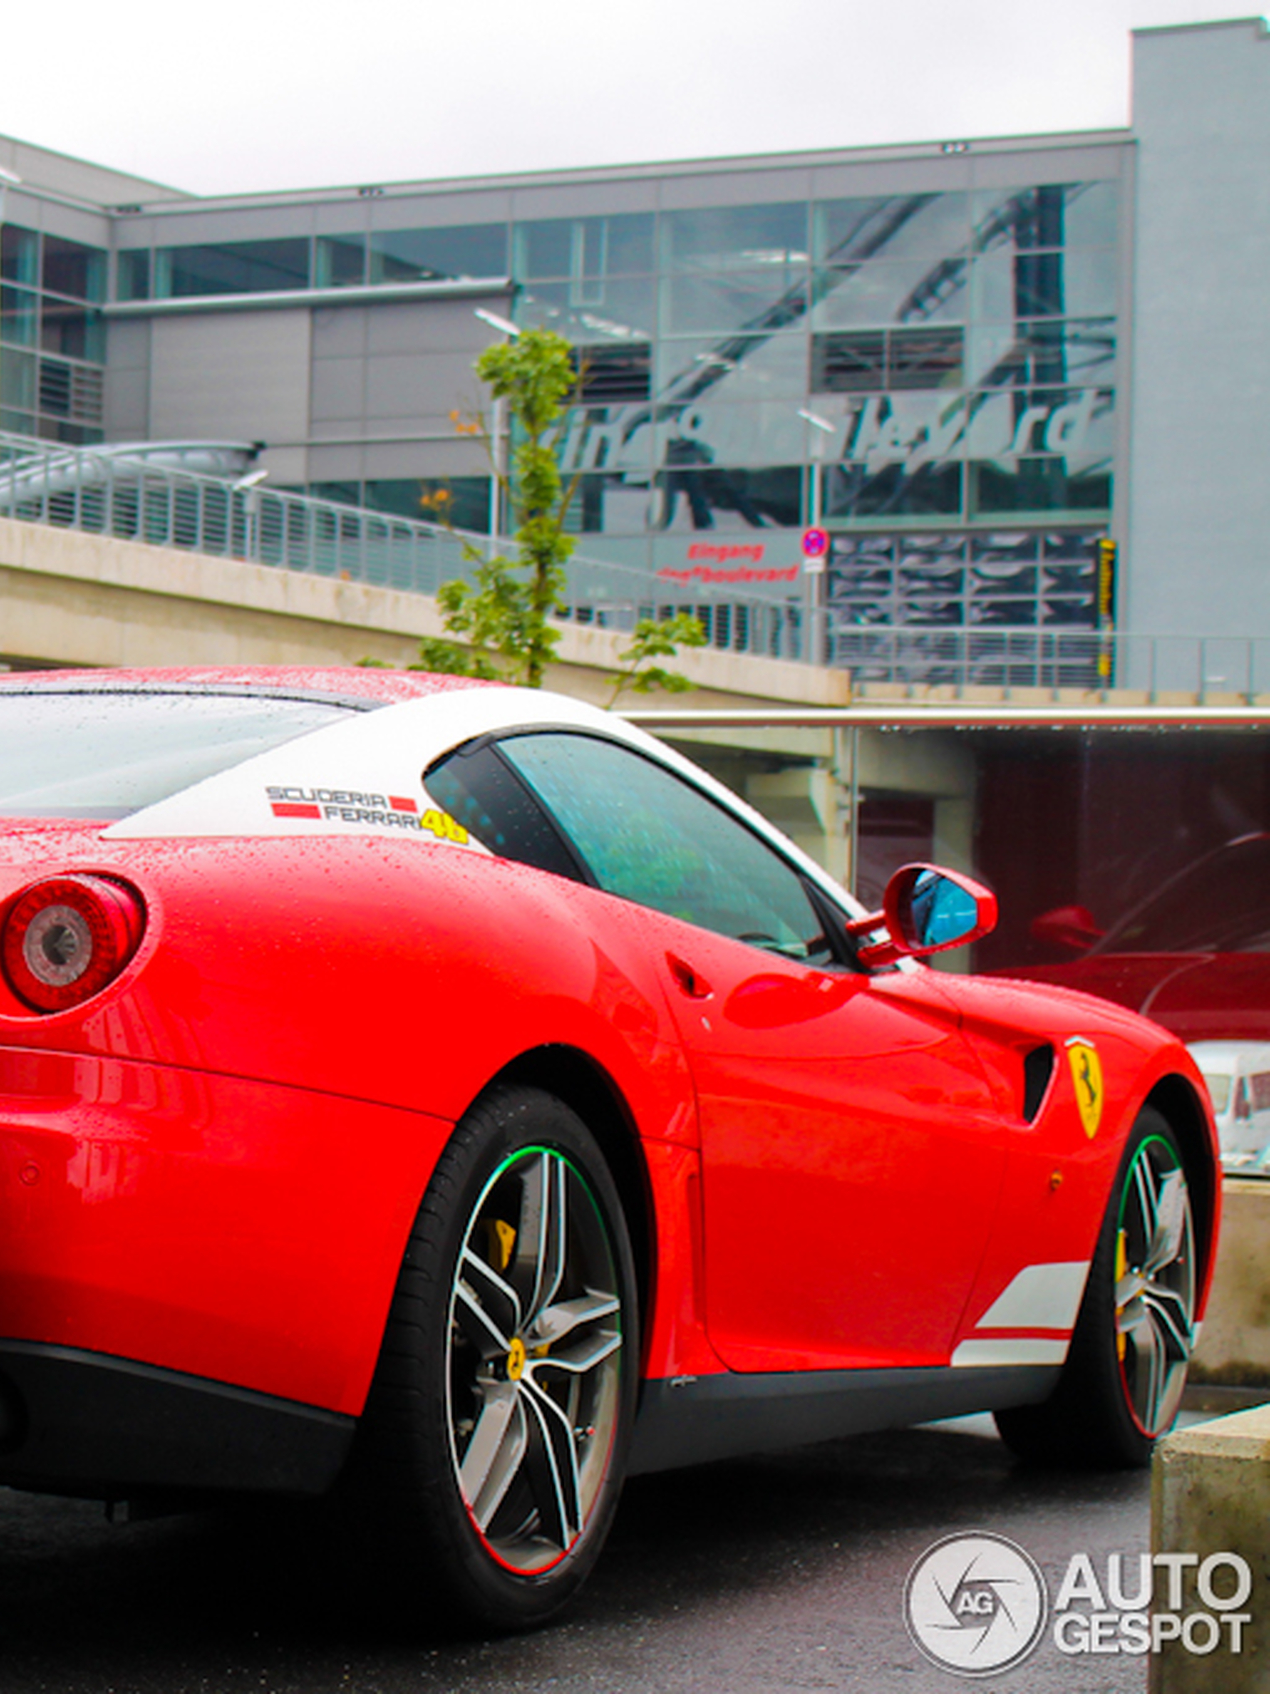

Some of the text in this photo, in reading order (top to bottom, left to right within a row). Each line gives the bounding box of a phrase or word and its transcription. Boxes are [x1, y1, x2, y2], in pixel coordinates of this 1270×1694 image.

[687, 542, 765, 563] Eingang
[265, 786, 388, 809] SCUDERIA
[323, 805, 422, 831] FERRARI
